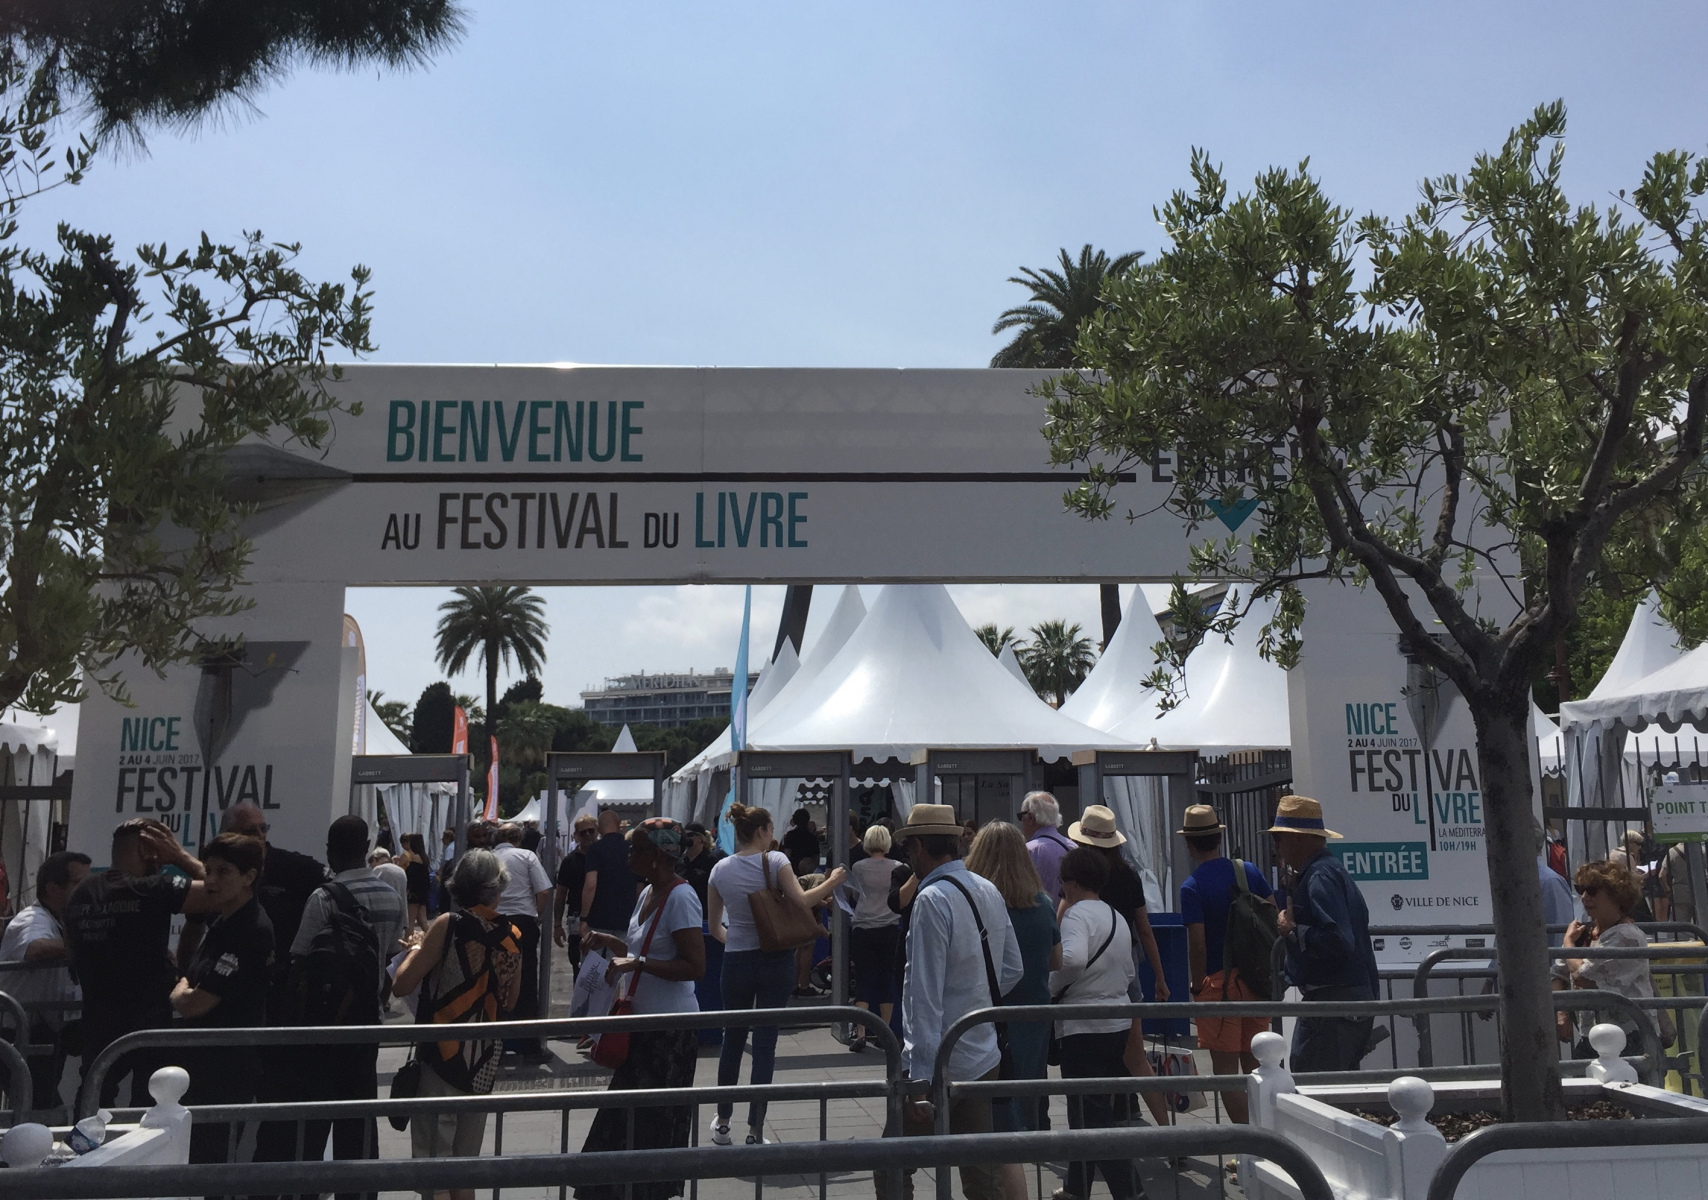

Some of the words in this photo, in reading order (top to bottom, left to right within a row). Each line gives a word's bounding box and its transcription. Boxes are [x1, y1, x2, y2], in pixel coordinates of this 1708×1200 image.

[386, 400, 645, 463] BIENVENUE
[381, 513, 421, 550] AU
[436, 492, 629, 550] FESTIVAL
[644, 512, 680, 549] DU
[695, 491, 809, 549] LIVRE
[121, 717, 182, 751] NICE
[1345, 703, 1399, 735] NICE
[1347, 738, 1353, 747] 2
[1355, 738, 1368, 747] AU
[1370, 738, 1376, 747] 4
[1377, 738, 1397, 747] JUIN
[1399, 738, 1418, 747] 2017
[119, 755, 125, 765] 2
[128, 755, 142, 765] AU
[144, 755, 151, 765] 4
[153, 754, 175, 764] JUIN
[178, 754, 200, 764] 2017
[1349, 749, 1479, 792] FESTIVA
[116, 764, 281, 813] FESTIVAL
[160, 813, 181, 833] DU
[1392, 793, 1411, 812] DU
[1413, 792, 1482, 824] LIVRE
[1656, 801, 1695, 815] POINT
[1699, 801, 1708, 814] T
[1438, 827, 1447, 838] LA
[1449, 826, 1486, 838] MÉDITERRA
[1439, 841, 1477, 851] 10H/19H
[1342, 845, 1423, 875] ENTRÉE
[1405, 897, 1434, 907] VILLE
[1436, 897, 1452, 907] DE
[1453, 896, 1479, 906] NICE
